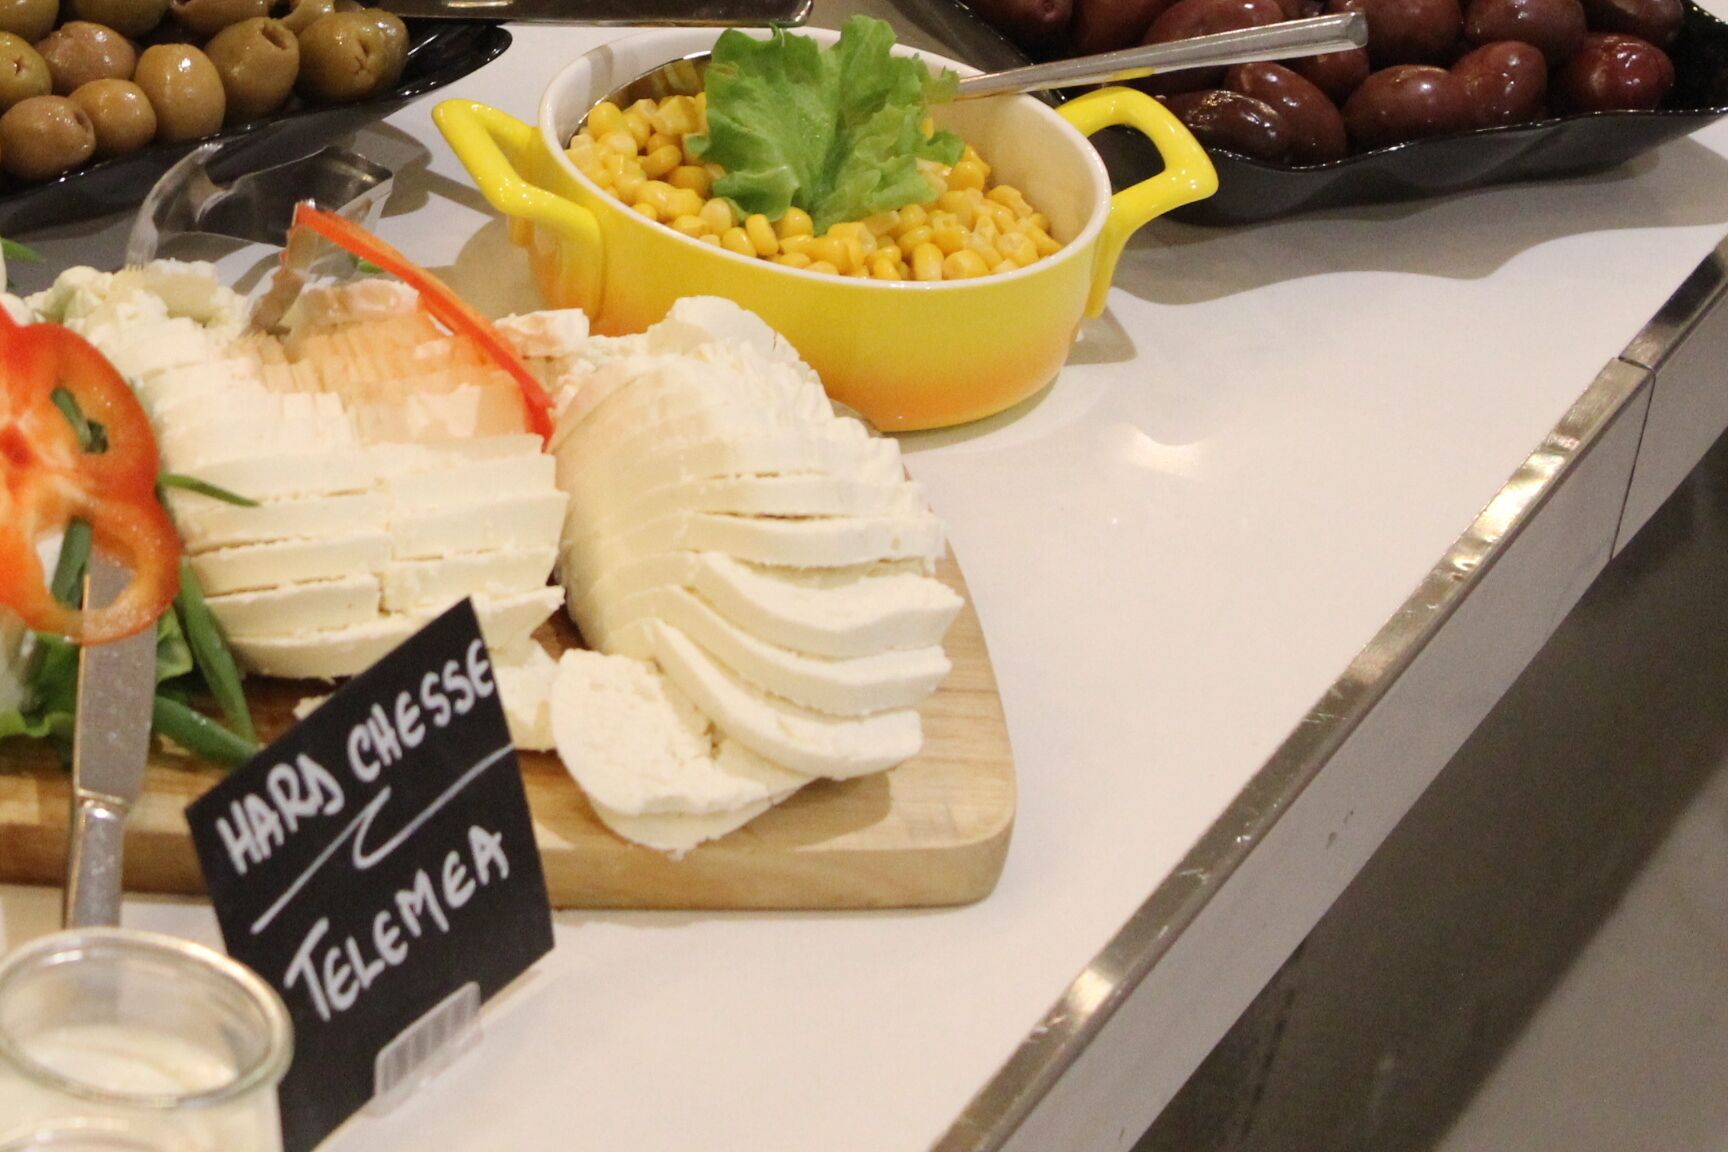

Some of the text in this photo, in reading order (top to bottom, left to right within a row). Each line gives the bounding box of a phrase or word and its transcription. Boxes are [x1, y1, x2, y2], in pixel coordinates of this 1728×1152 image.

[216, 637, 496, 875] HARD CHESSE
[284, 824, 509, 1022] TELEMEA
